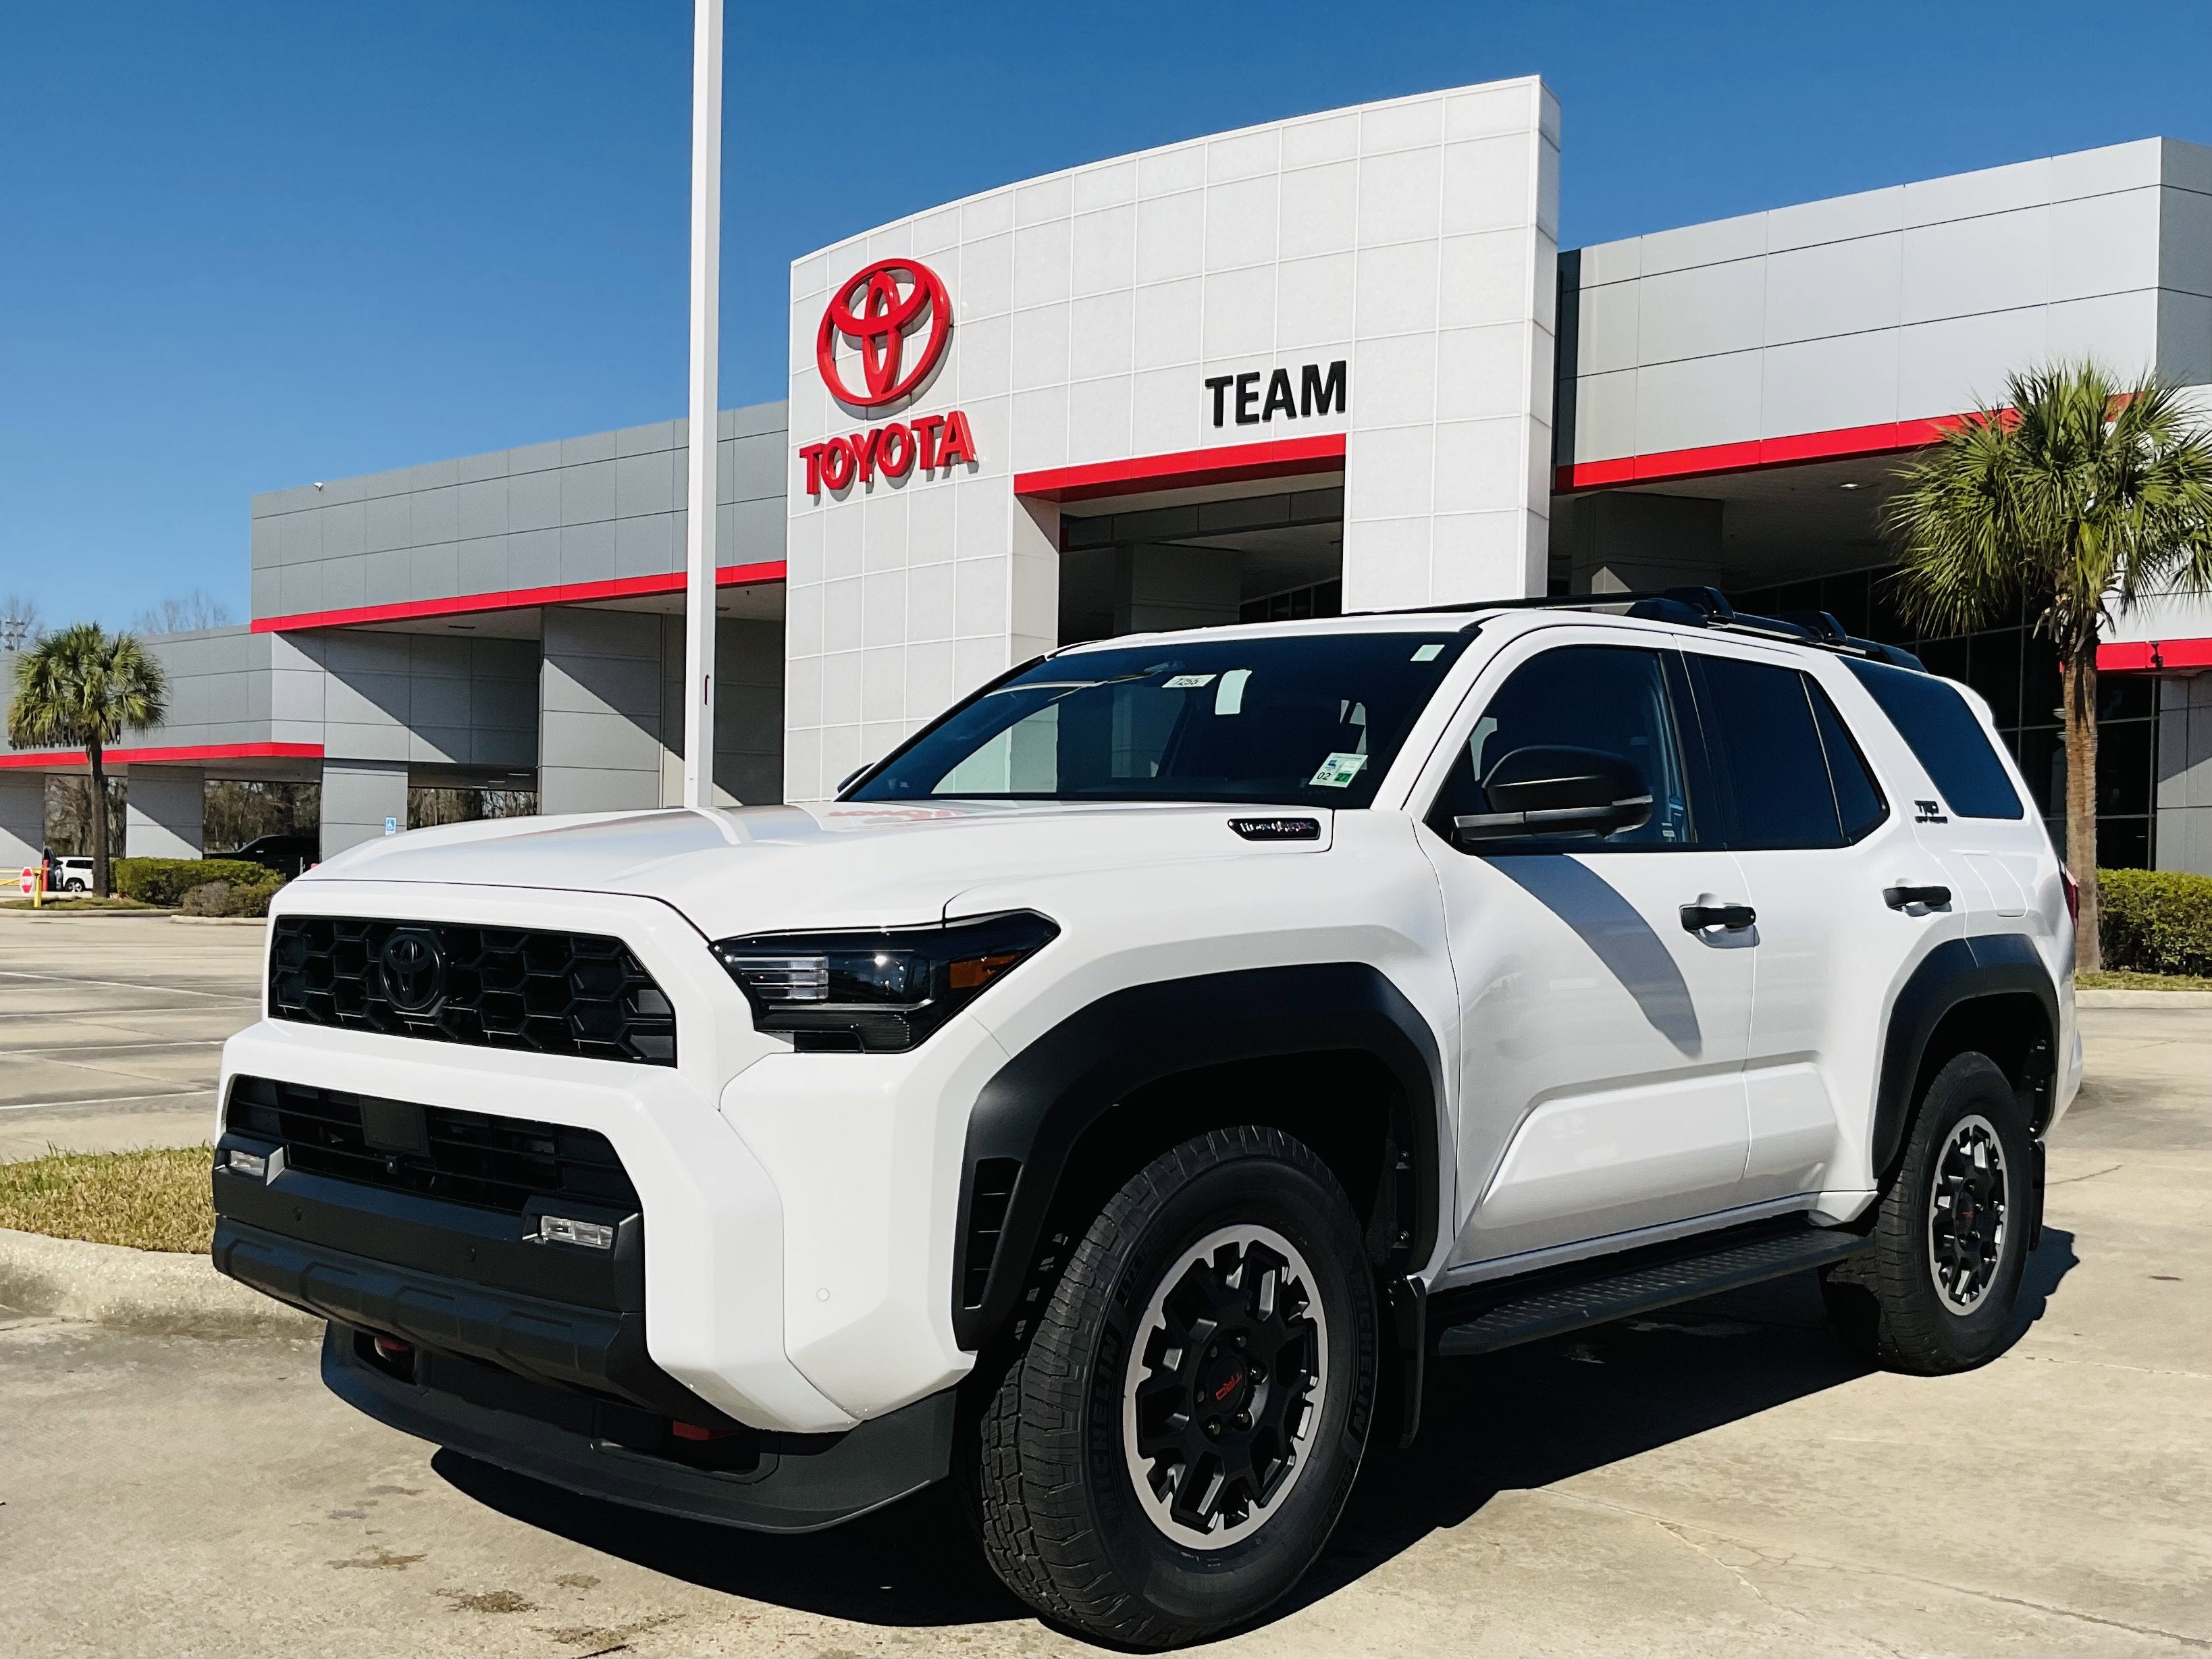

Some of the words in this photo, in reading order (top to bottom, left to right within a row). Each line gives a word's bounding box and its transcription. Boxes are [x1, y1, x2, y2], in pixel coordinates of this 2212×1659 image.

[1205, 360, 1346, 428] TEAM
[799, 410, 976, 496] TOYOTA
[1317, 772, 1332, 781] 02
[1334, 772, 1351, 783] 27
[1092, 1334, 1119, 1519] MICHELIN
